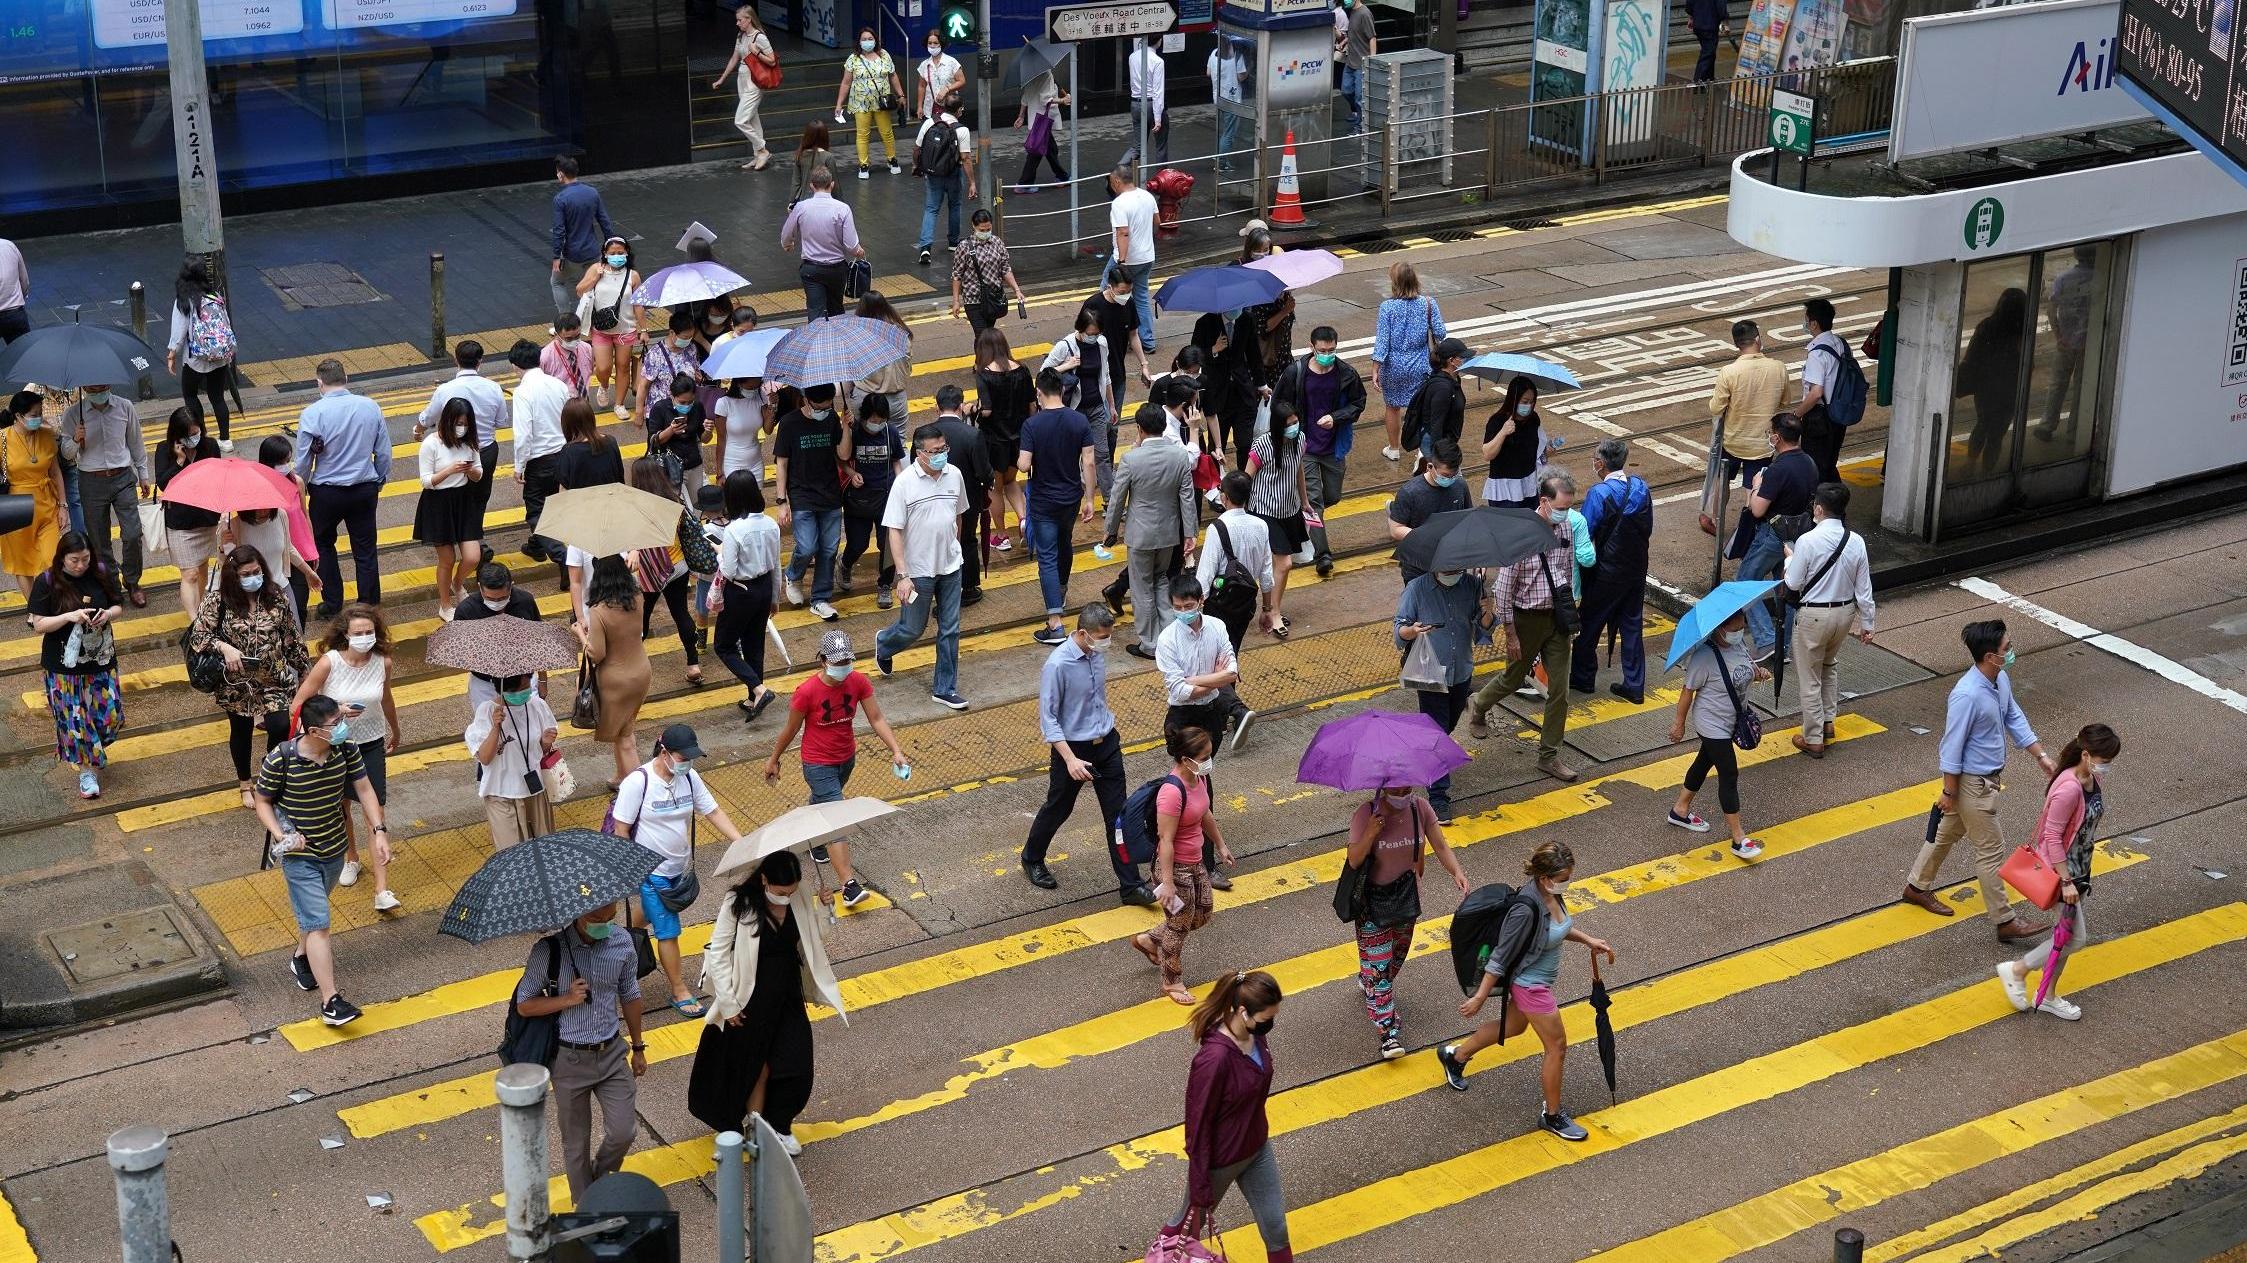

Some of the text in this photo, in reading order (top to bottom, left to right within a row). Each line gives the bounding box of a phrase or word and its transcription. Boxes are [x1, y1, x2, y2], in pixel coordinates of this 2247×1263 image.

[244, 6, 270, 15] 7.1044
[463, 4, 487, 13] 0.6123
[1063, 13, 1080, 22] Des
[1082, 11, 1110, 20] Voeux
[1112, 8, 1135, 18] Road
[1137, 5, 1167, 16] Central
[358, 12, 394, 22] NZD/USD
[246, 22, 271, 31] 1.0962
[1091, 20, 1140, 36] 德輔道中
[10, 26, 35, 38] 1.46
[1300, 59, 1324, 70] PCCW
